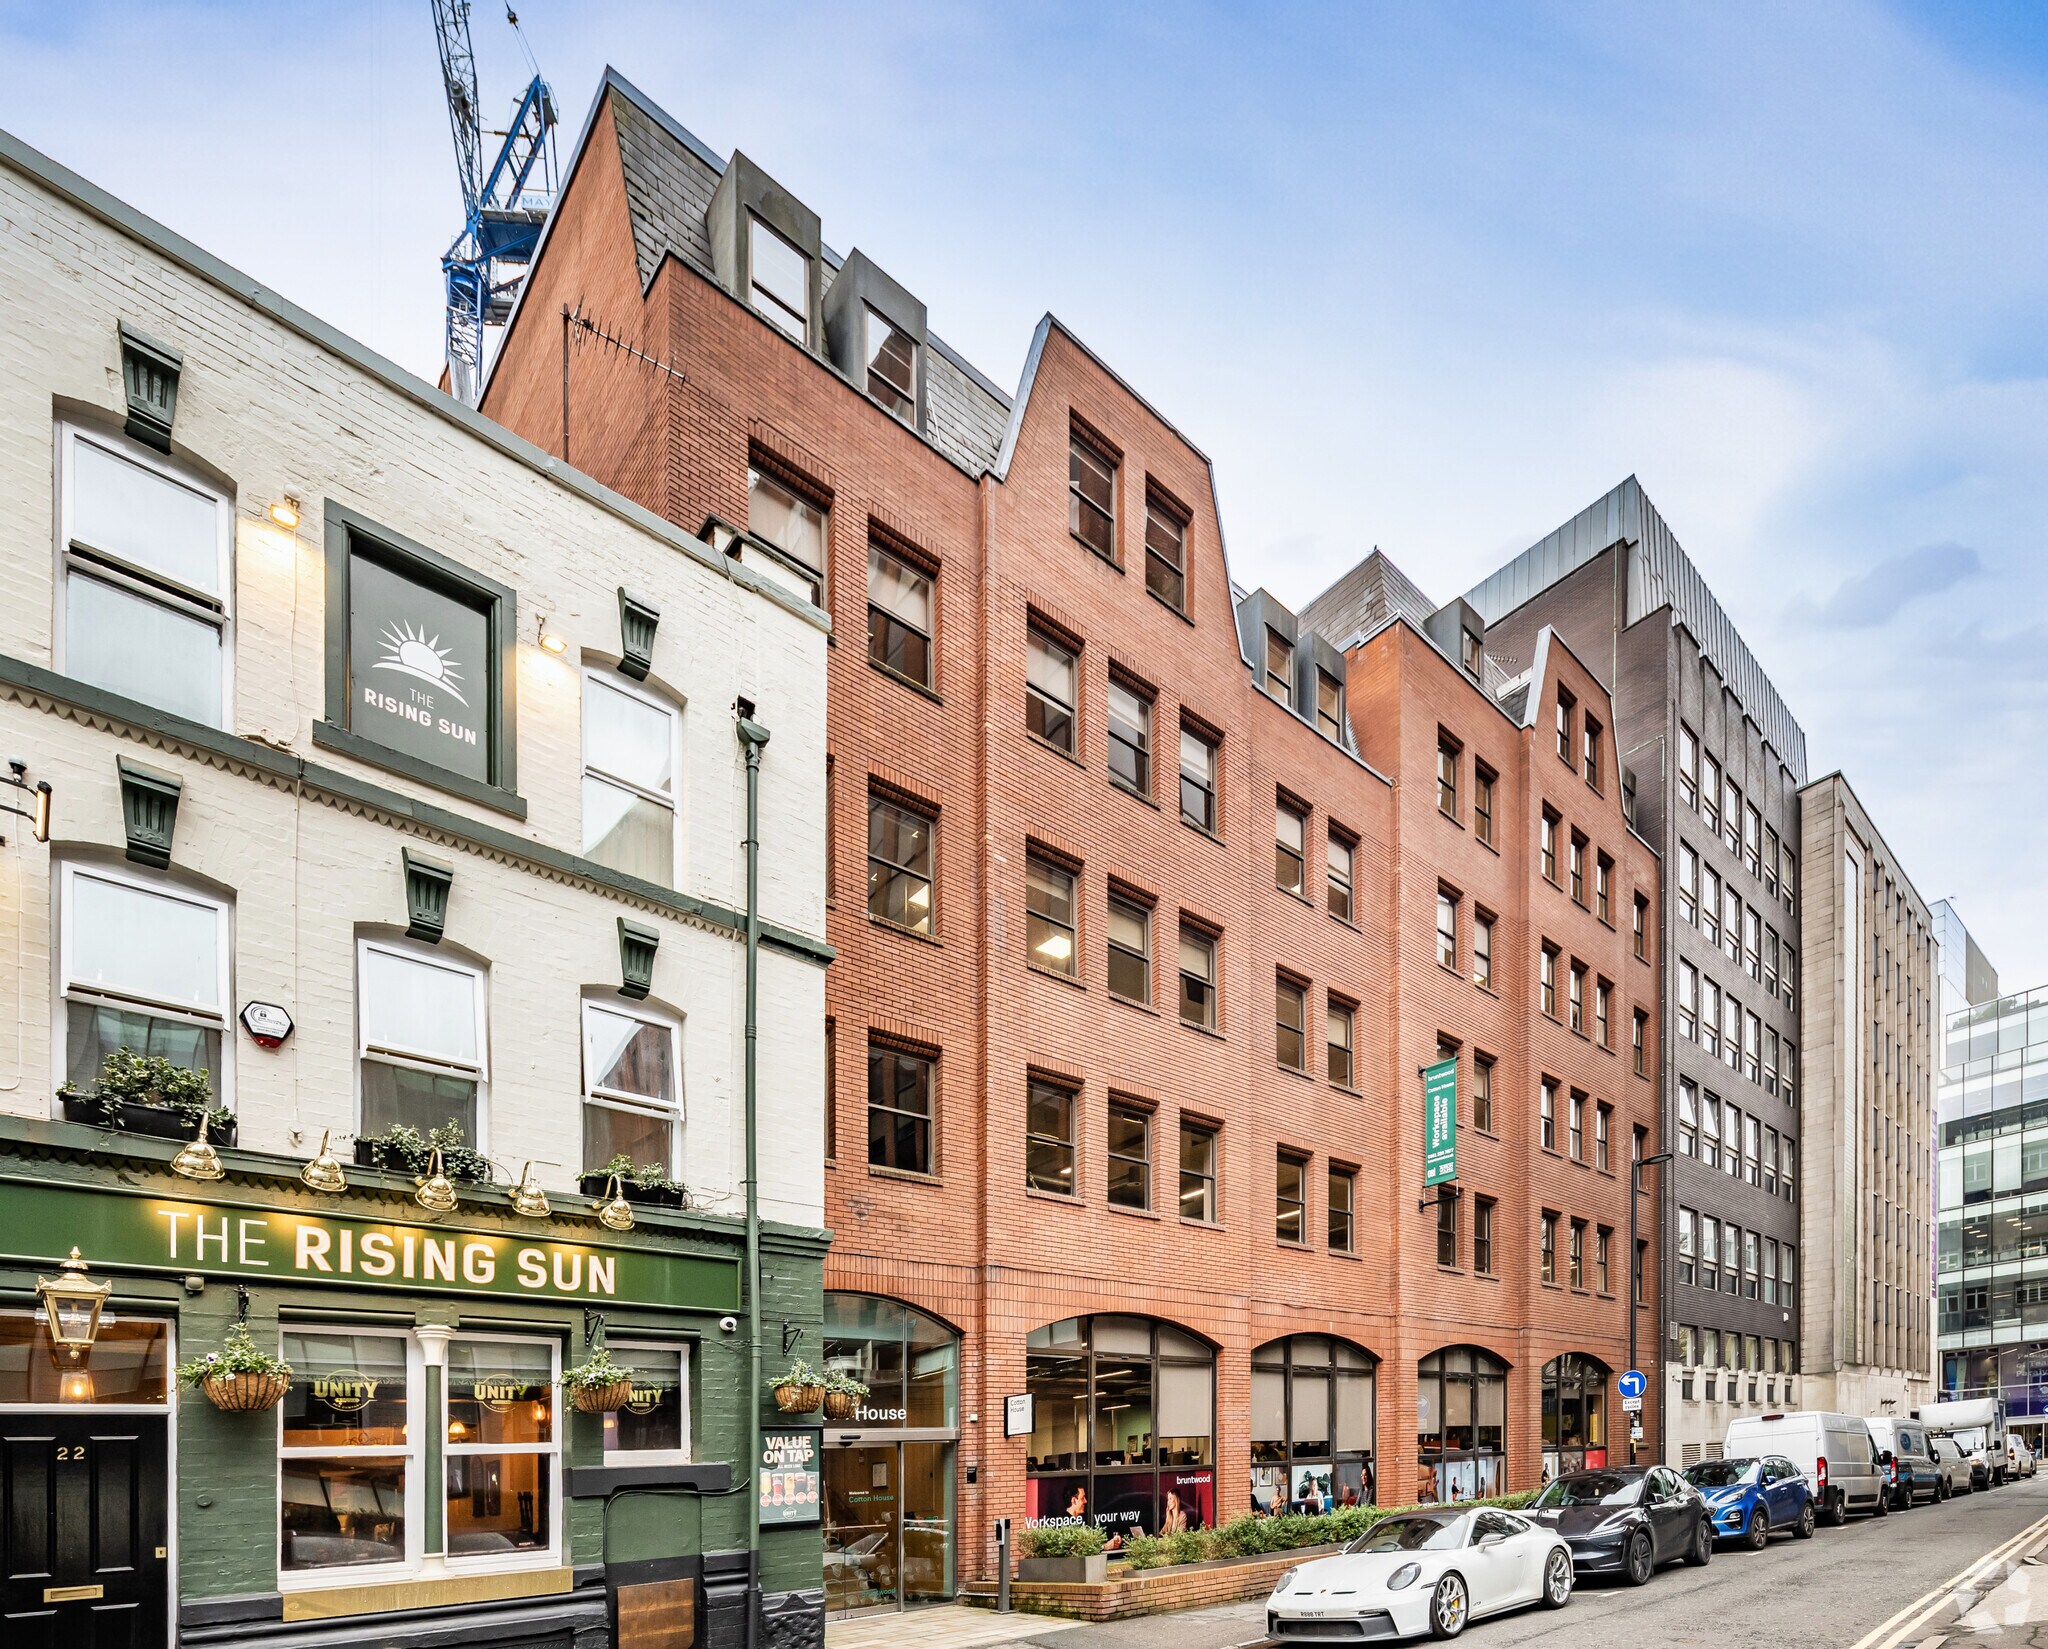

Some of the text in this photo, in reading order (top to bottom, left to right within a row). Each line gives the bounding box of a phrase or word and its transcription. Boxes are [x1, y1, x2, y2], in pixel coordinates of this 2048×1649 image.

[409, 687, 435, 710] THE
[364, 687, 476, 746] RISING SUN
[1427, 1068, 1454, 1081] bruntwood
[1432, 1095, 1441, 1149] Workspace
[157, 1209, 616, 1295] THE RISING SUN
[314, 1381, 379, 1398] UNITY
[474, 1383, 528, 1401] UNITY
[628, 1389, 663, 1404] NITY
[855, 1405, 907, 1421] House
[765, 1435, 812, 1450] VALUE
[56, 1446, 85, 1460] 22
[763, 1449, 814, 1463] ON TAP
[1176, 1474, 1211, 1485] bruntwood
[1094, 1512, 1117, 1526] your
[1120, 1510, 1141, 1523] way
